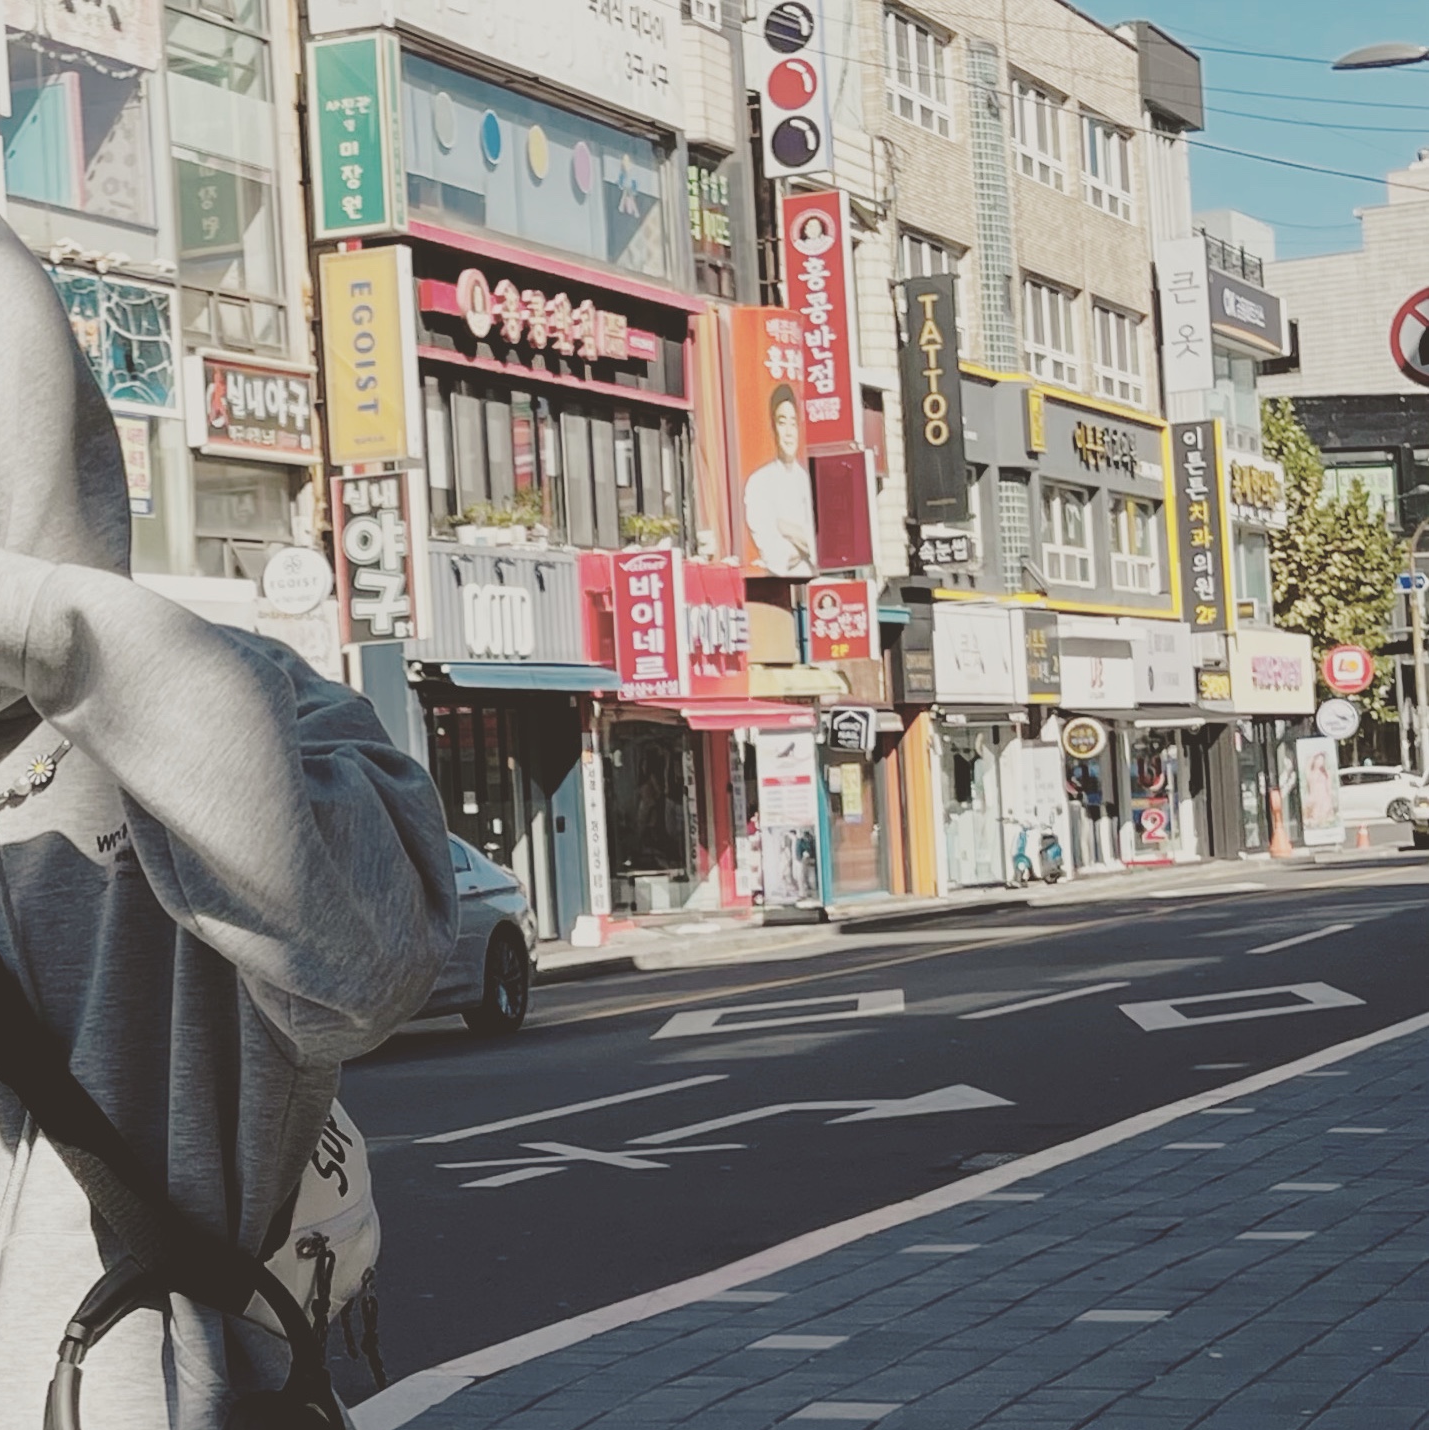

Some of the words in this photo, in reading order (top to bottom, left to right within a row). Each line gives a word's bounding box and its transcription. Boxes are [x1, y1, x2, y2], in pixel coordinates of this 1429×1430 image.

[338, 140, 364, 220] 미장원
[350, 281, 380, 415] EGOIST
[798, 257, 837, 394] 홍콩반점
[918, 294, 949, 445] TATTOO
[227, 371, 310, 430] 실내야구
[342, 509, 410, 635] 야구
[918, 539, 969, 563] 속눈썹
[628, 573, 669, 680] 바이네르
[1195, 605, 1218, 625] 2F
